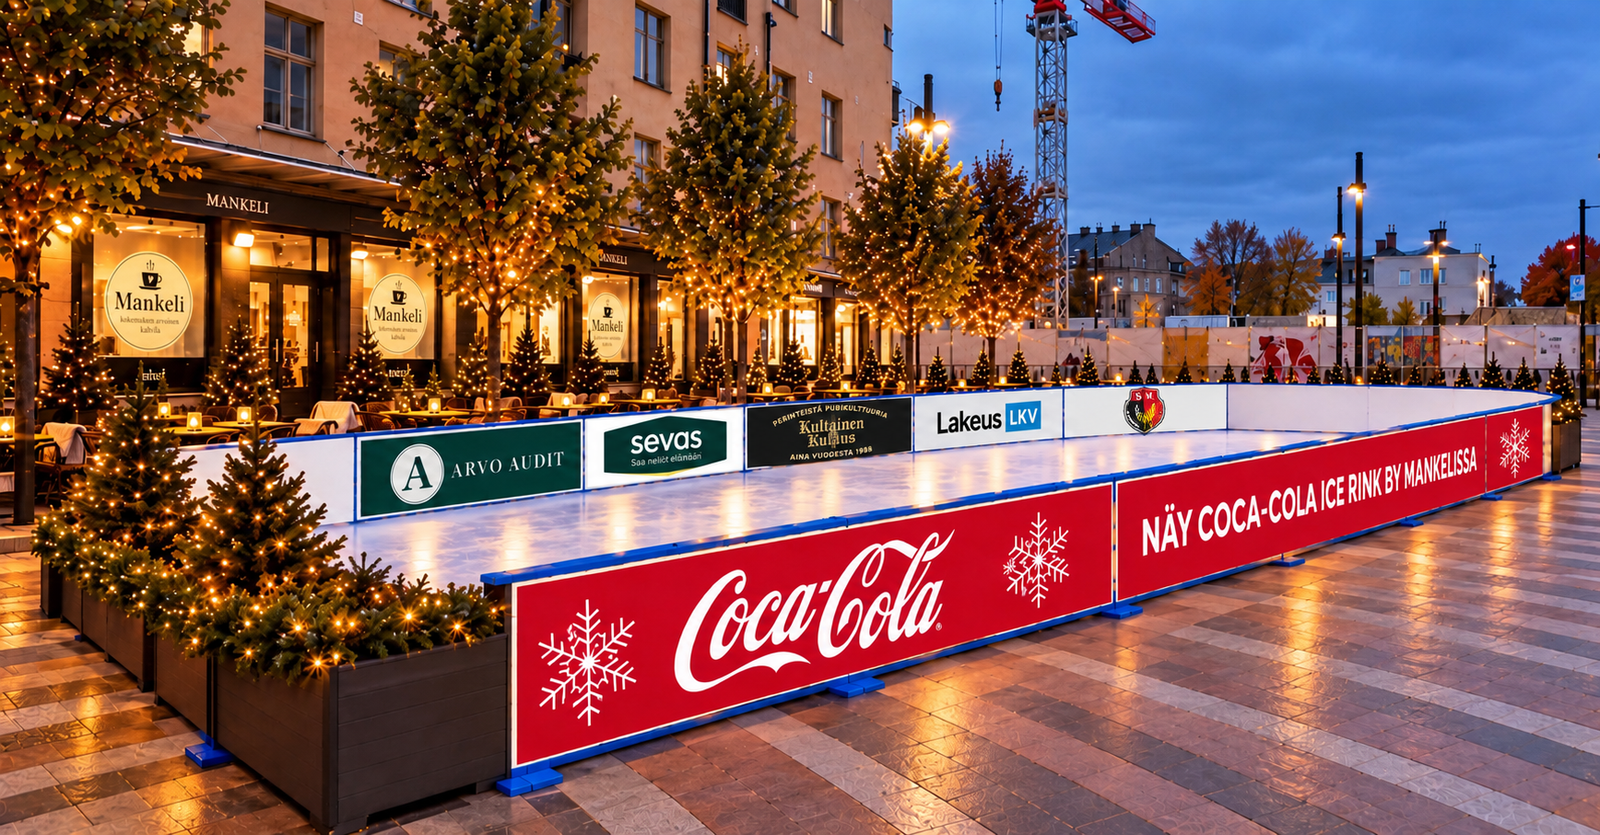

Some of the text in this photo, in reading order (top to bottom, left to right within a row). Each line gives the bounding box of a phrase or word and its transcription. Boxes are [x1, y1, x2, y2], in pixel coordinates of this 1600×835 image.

[206, 193, 269, 215] MANKELI
[600, 253, 628, 265] ANKELI
[115, 291, 184, 312] Mankeli
[374, 306, 422, 323] Mankeli
[592, 319, 623, 332] Mankeli
[1136, 392, 1142, 400] S
[798, 418, 864, 434] Kultainen
[937, 408, 1038, 434] Lakeus LKV
[630, 430, 702, 454] sevas
[451, 452, 564, 478] ARVO AUDIT
[631, 458, 646, 466] Saa
[402, 456, 433, 492] A
[1142, 446, 1477, 556] NÄY COCA-COLA ICE RINK BY MANKELISSA
[674, 529, 955, 692] Coca-Cola
